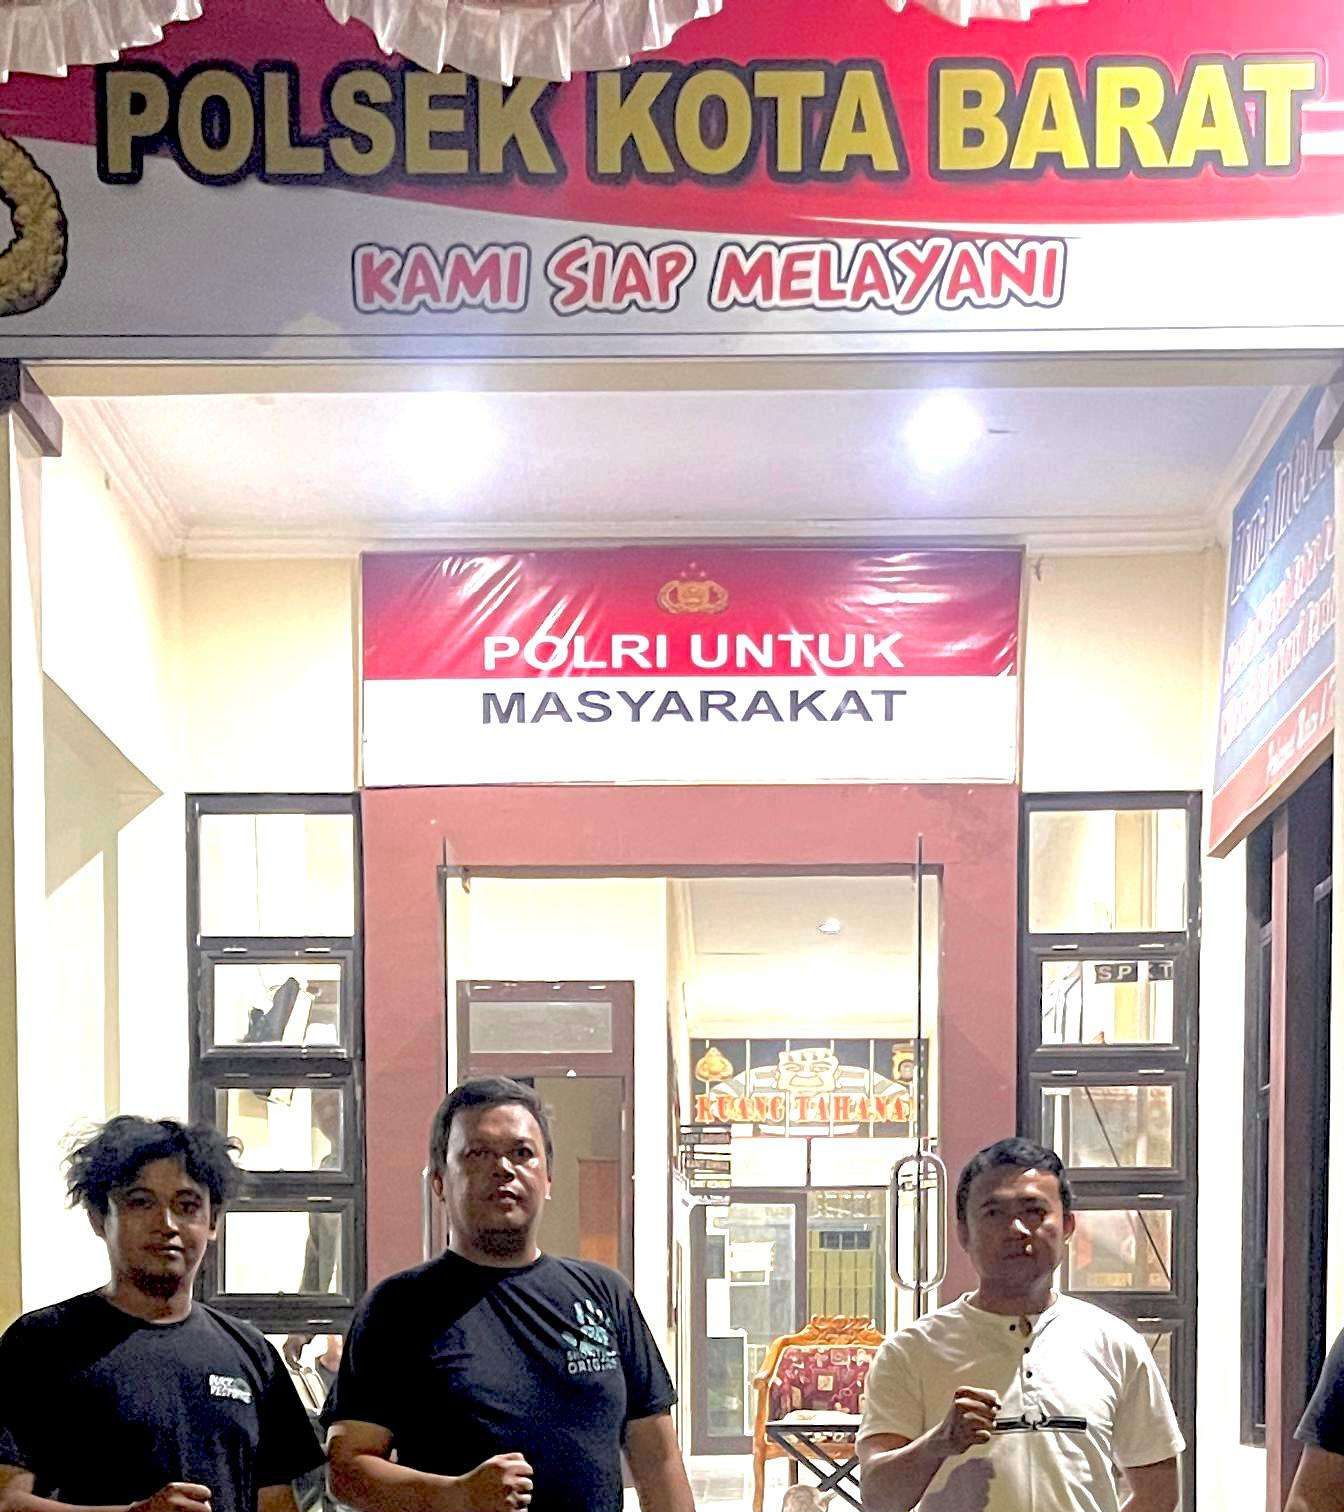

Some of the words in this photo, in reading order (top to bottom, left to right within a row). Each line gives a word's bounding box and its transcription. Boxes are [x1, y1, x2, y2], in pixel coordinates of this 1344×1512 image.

[104, 66, 558, 180] POLSEK
[596, 64, 904, 178] KOTA
[940, 58, 1320, 172] BARAT
[358, 242, 530, 308] KAMI
[552, 240, 694, 308] SIAP
[713, 239, 1063, 308] MELAYANI
[484, 632, 670, 671] POLRI
[689, 631, 905, 669] UNTUK
[482, 688, 907, 724] MASYARAKAT
[790, 1093, 915, 1124] TAHANA
